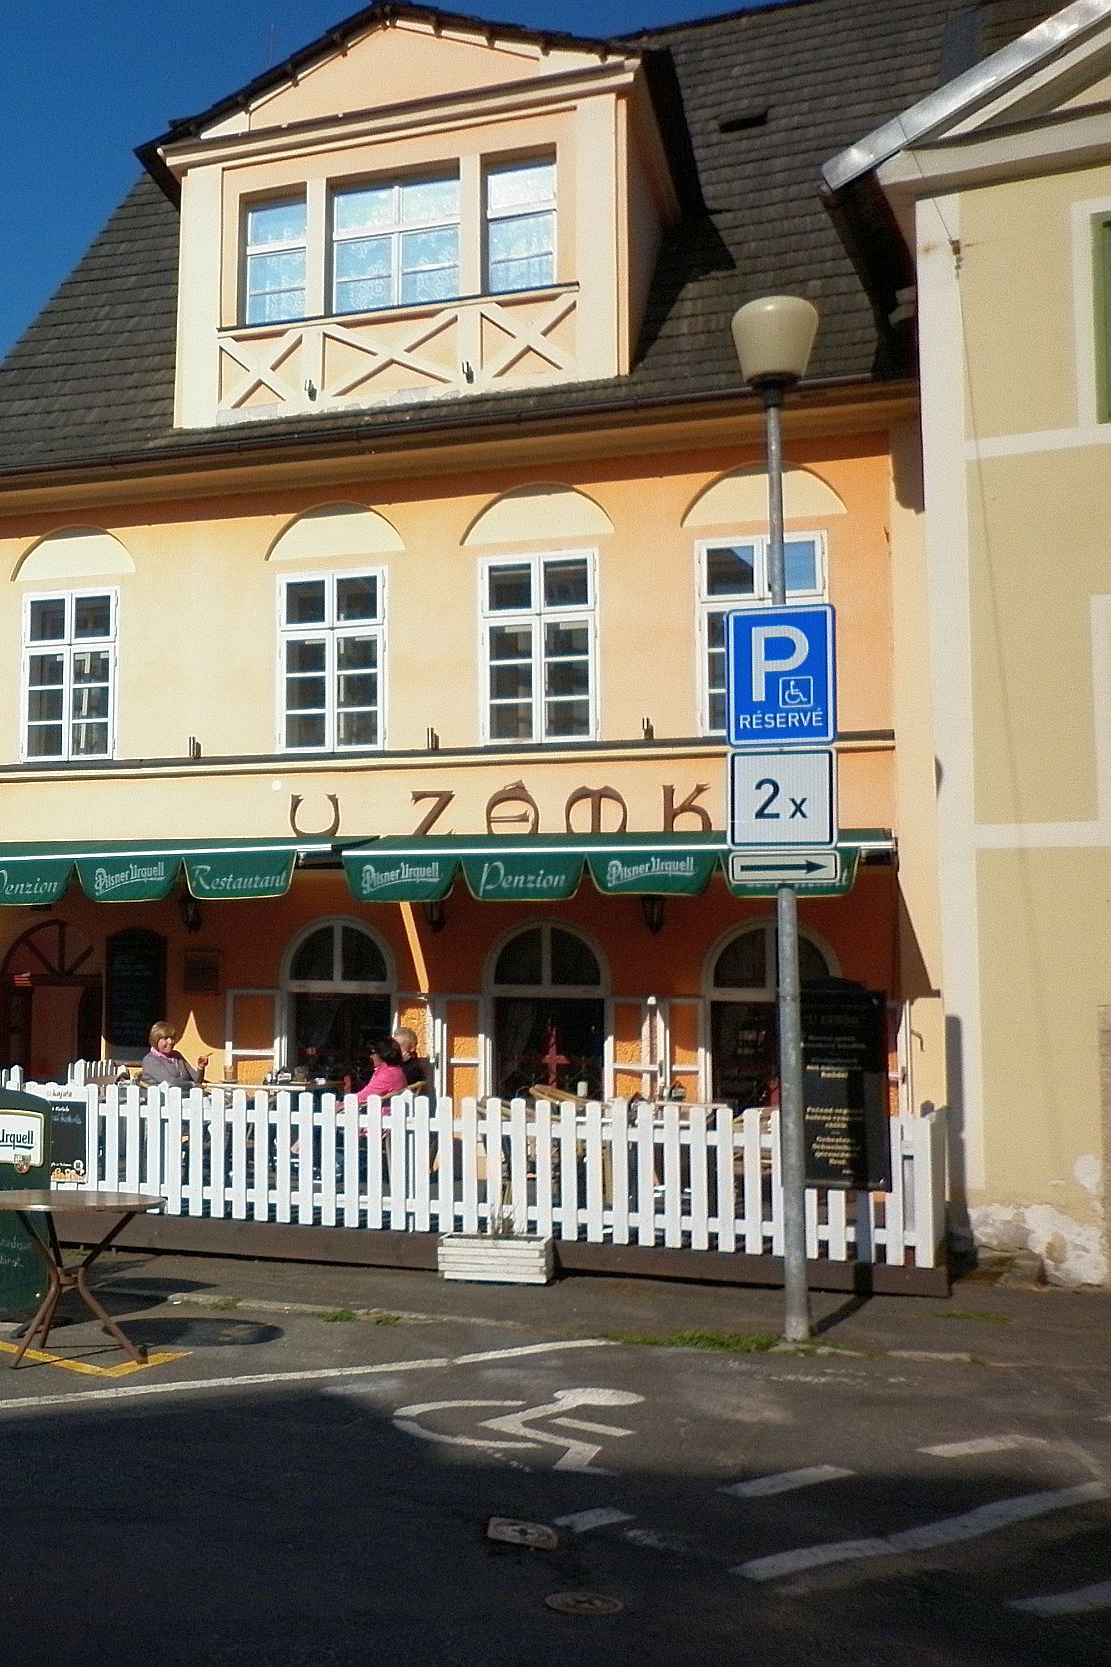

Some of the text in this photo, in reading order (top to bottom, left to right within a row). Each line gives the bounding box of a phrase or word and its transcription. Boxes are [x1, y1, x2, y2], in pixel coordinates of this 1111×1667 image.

[751, 625, 809, 702] P
[739, 708, 823, 729] RÉSERVÉ
[290, 793, 340, 838] U
[94, 862, 165, 896] Pilsner Urquell
[191, 865, 286, 890] Restaurant
[362, 862, 440, 894] Pilsner Urquell
[479, 861, 566, 897] Penzion
[607, 856, 694, 887] Pilsner Urquell
